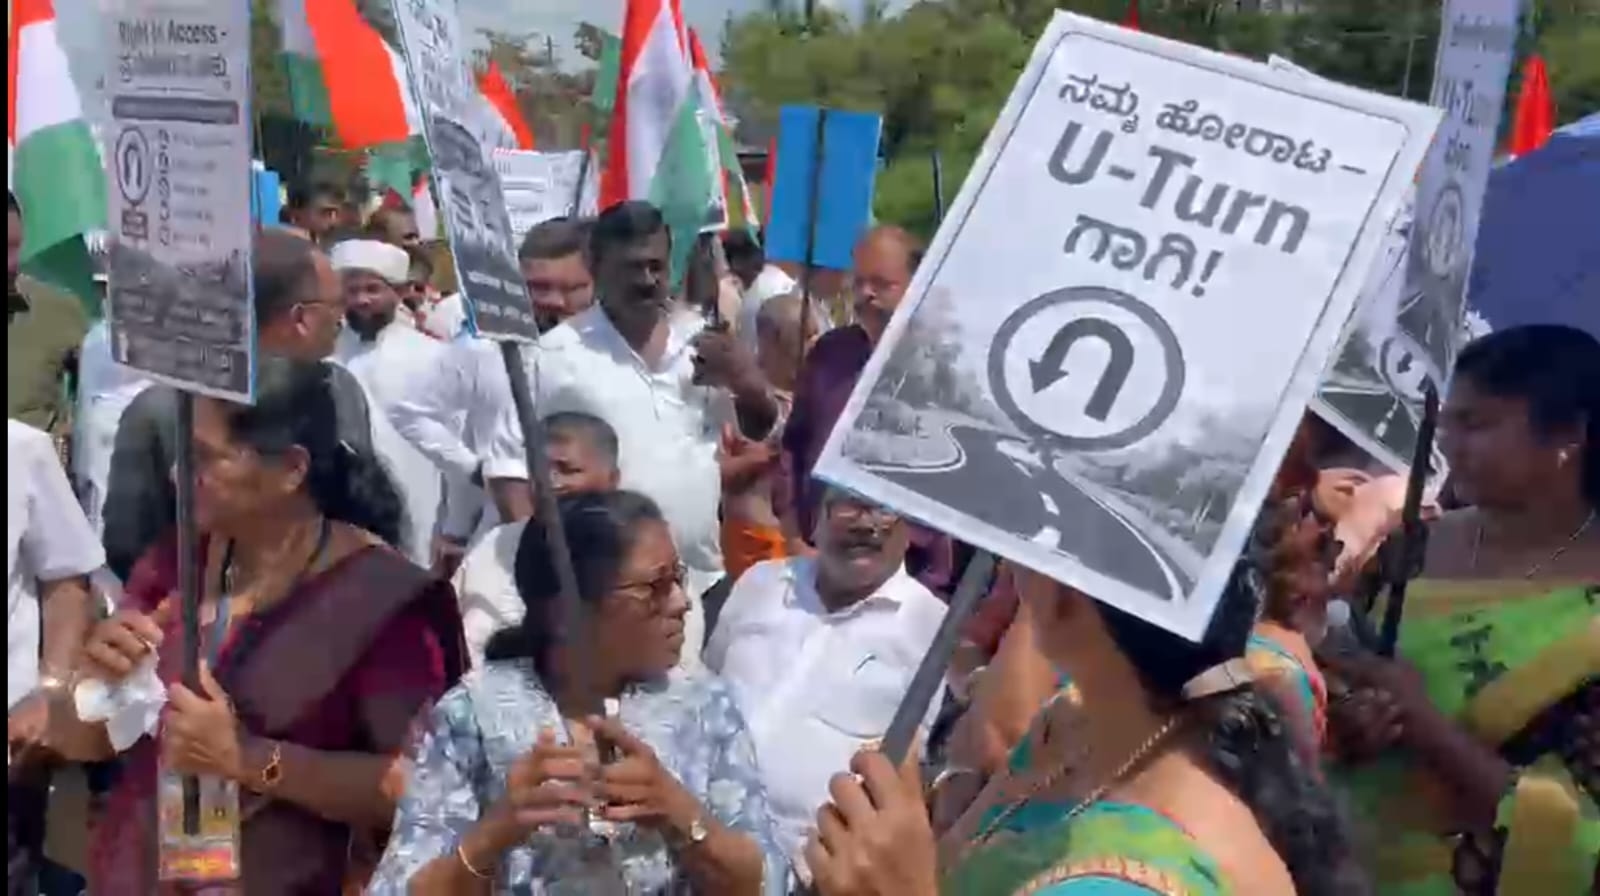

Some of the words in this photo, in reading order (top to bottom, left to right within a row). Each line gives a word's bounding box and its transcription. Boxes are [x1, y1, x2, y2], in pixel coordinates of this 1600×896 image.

[168, 19, 218, 45] Access
[1059, 74, 1139, 134] ನಮ್ಮ
[1156, 99, 1332, 174] ಹೋರಾಟ
[1047, 120, 1311, 255] U-Turn
[1063, 213, 1224, 298] ಗಾಗಿ!
